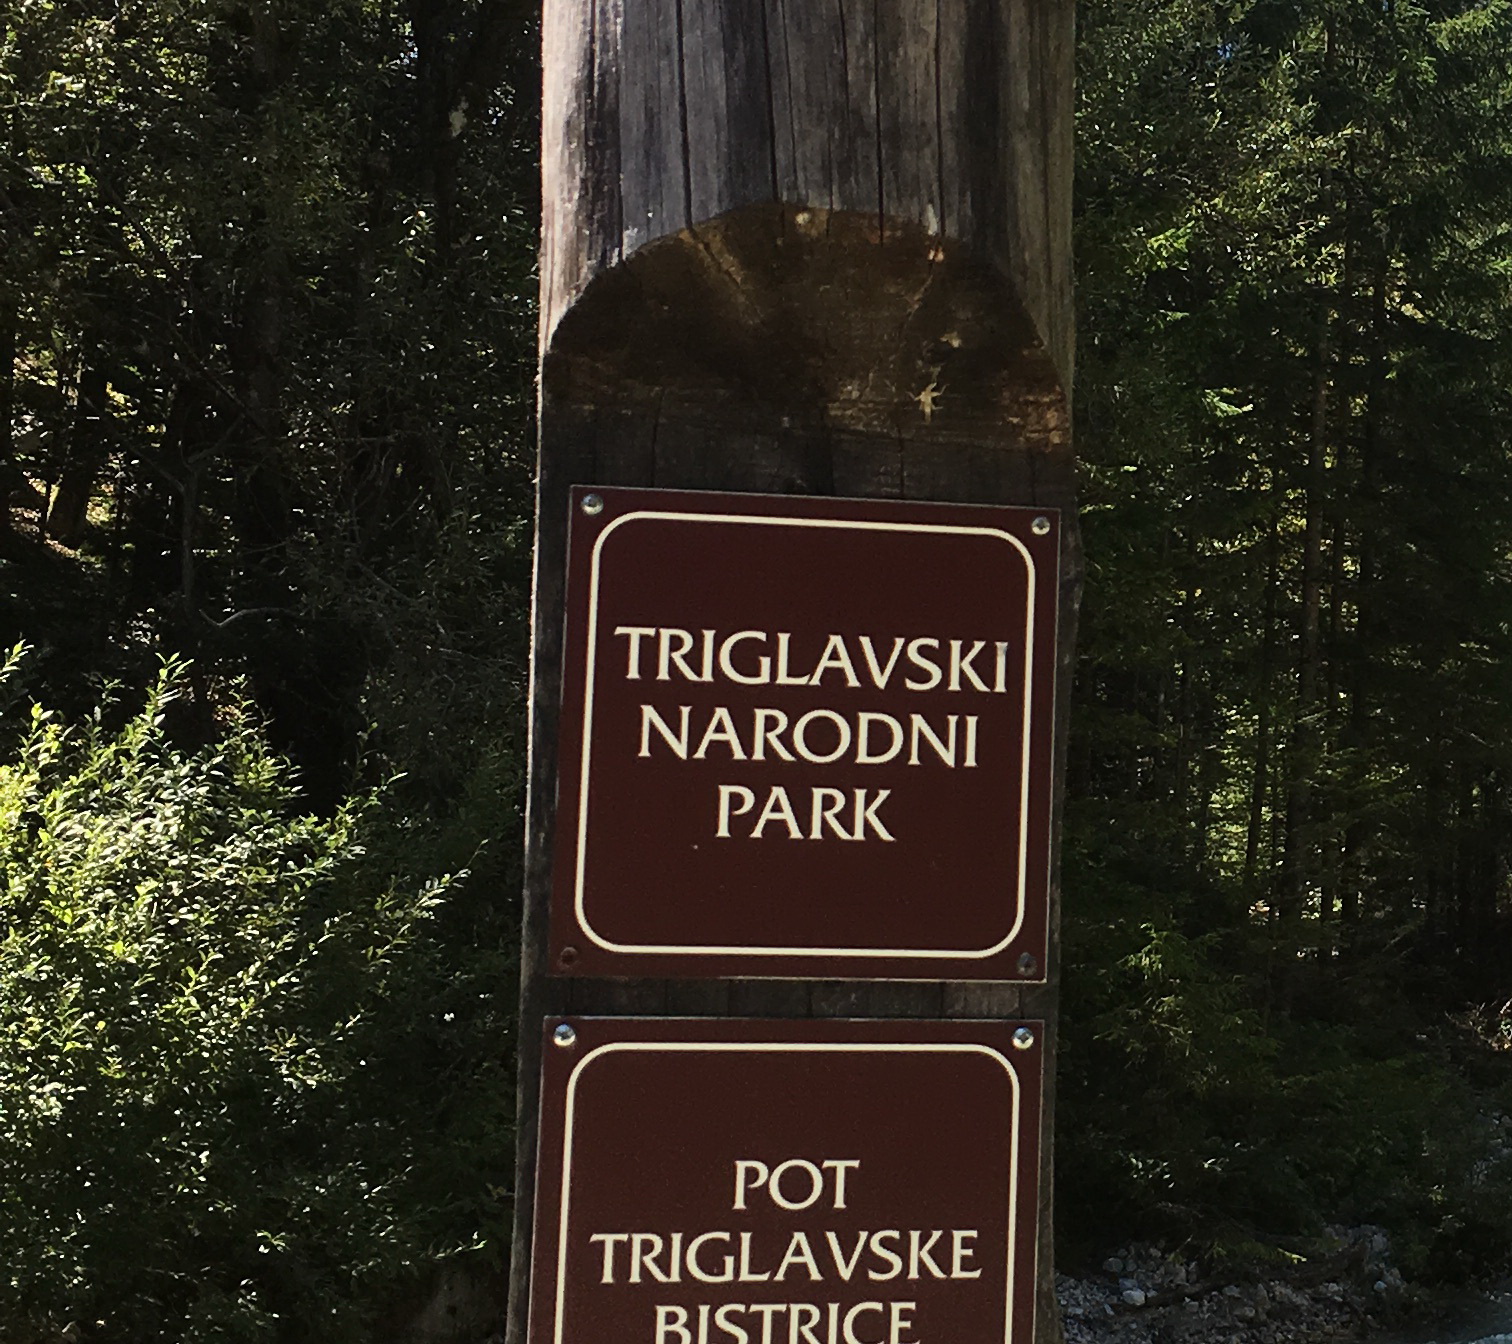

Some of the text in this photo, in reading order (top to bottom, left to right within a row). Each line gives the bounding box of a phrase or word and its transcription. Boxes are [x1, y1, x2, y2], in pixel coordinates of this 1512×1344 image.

[613, 626, 1009, 693] TRIGLAVSKI
[637, 704, 979, 769] NARODNI
[715, 784, 896, 842] PARK
[732, 1159, 861, 1211] POT
[589, 1229, 983, 1284] TRIGLAVSKE
